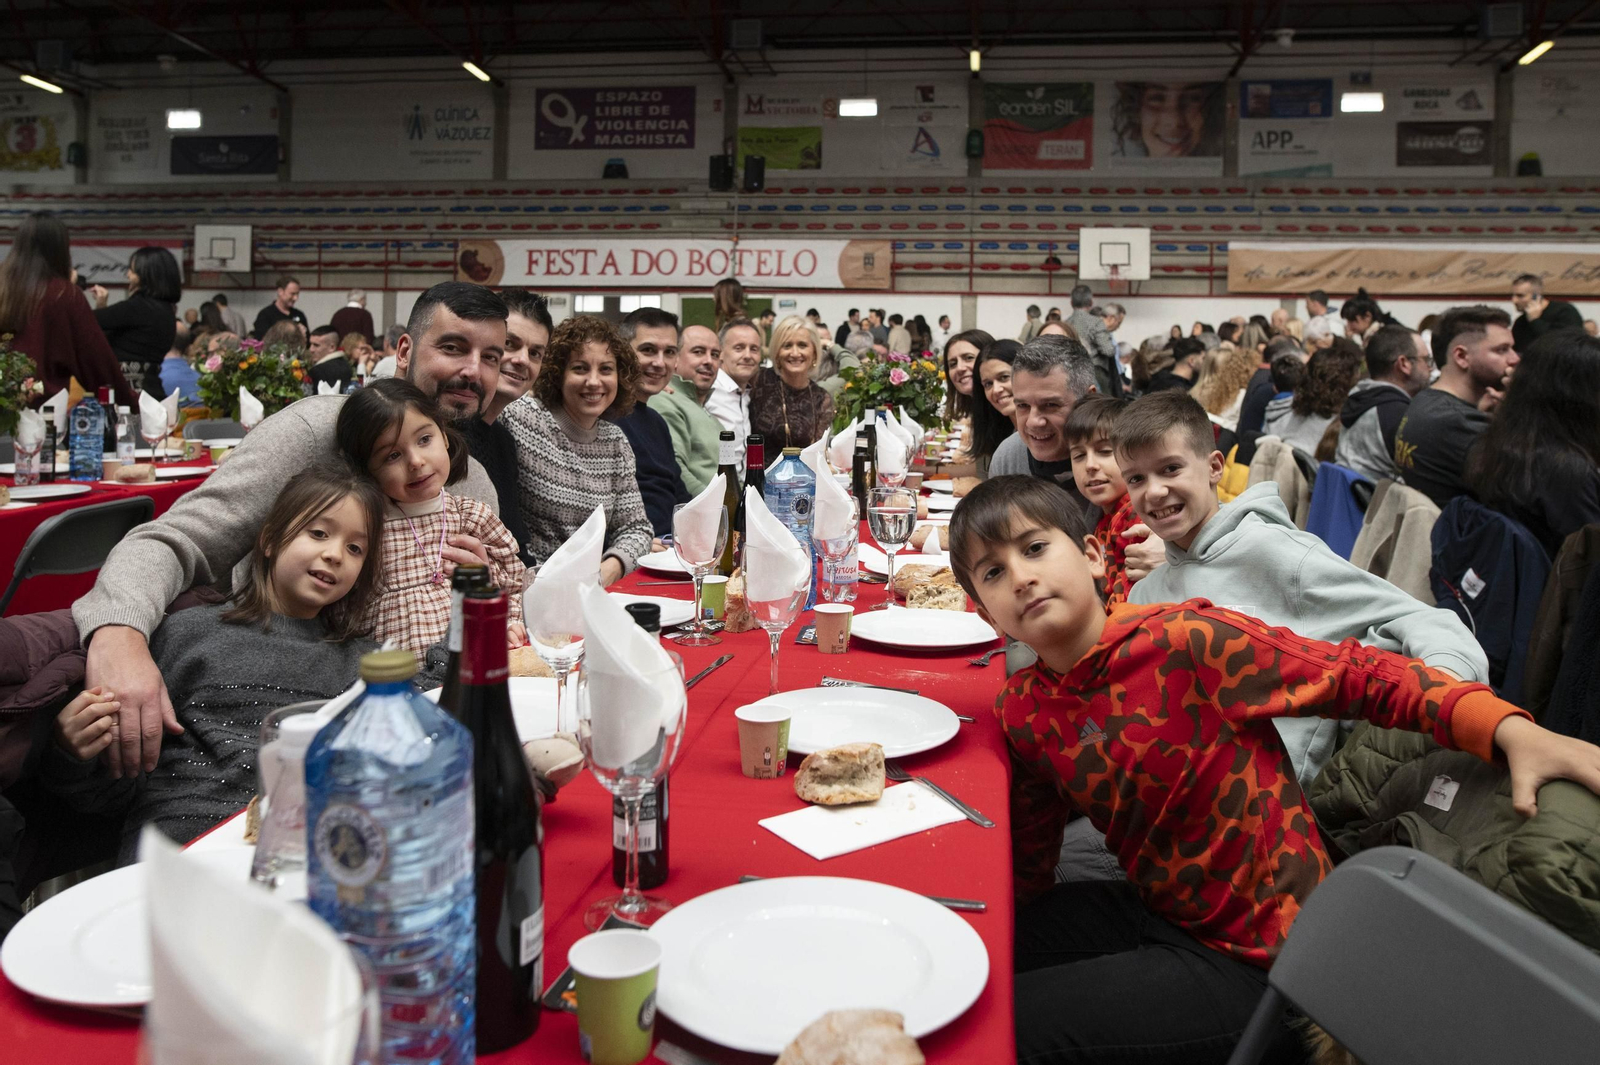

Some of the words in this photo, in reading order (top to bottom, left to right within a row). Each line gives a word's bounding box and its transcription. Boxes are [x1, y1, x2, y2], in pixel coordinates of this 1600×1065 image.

[595, 91, 663, 103] ESPAZO
[595, 105, 643, 117] LIBRE
[648, 105, 671, 116] DE
[1054, 98, 1080, 116] SIL
[594, 119, 690, 131] VIOLENCIA
[435, 123, 492, 142] VÁZQUEZ
[594, 133, 688, 146] MACHISTA
[525, 249, 622, 276] FESTA
[630, 249, 678, 276] DO
[685, 249, 818, 277] BOTELO
